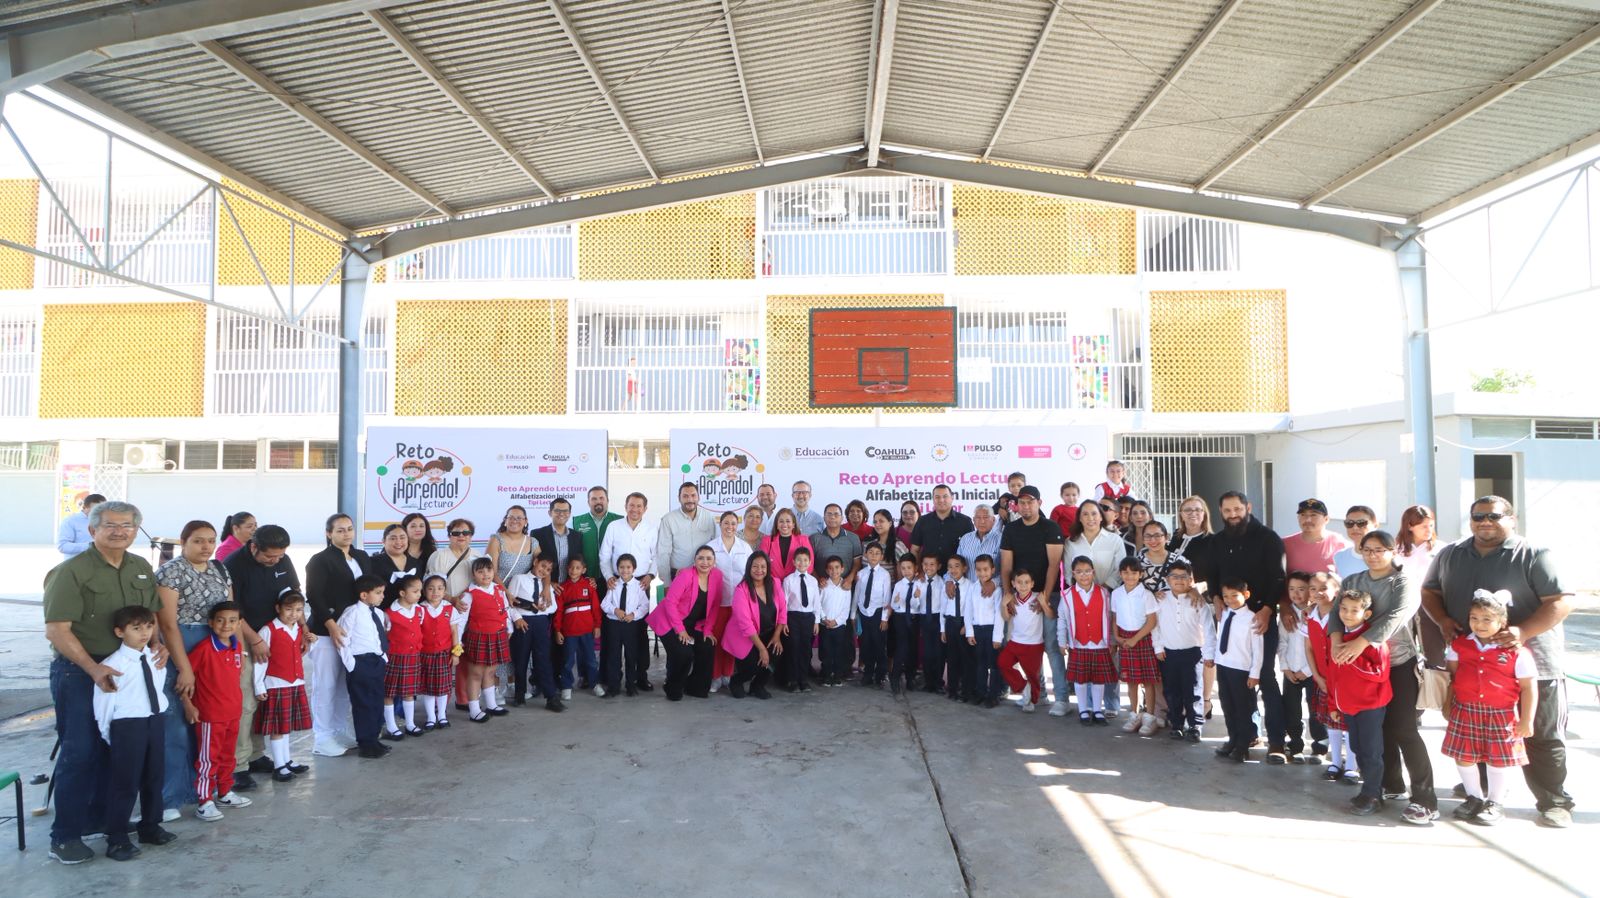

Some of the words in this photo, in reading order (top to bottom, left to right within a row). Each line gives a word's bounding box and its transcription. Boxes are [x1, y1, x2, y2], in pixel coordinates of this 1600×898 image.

[396, 442, 435, 460] Reto
[697, 442, 731, 458] Reto
[795, 446, 849, 456] Educación
[865, 445, 916, 458] COAHUILA
[839, 472, 879, 485] Reto
[882, 471, 956, 488] Aprendo
[960, 471, 1009, 485] Lectu
[393, 477, 459, 505] ¡Aprendo!
[497, 485, 518, 493] Reto
[518, 485, 555, 494] Aprendo
[556, 485, 588, 493] Lectura
[865, 488, 959, 501] Alfabetizan
[961, 488, 1000, 501] Inicial
[417, 495, 454, 511] Lectura
[717, 491, 749, 506] Lectura
